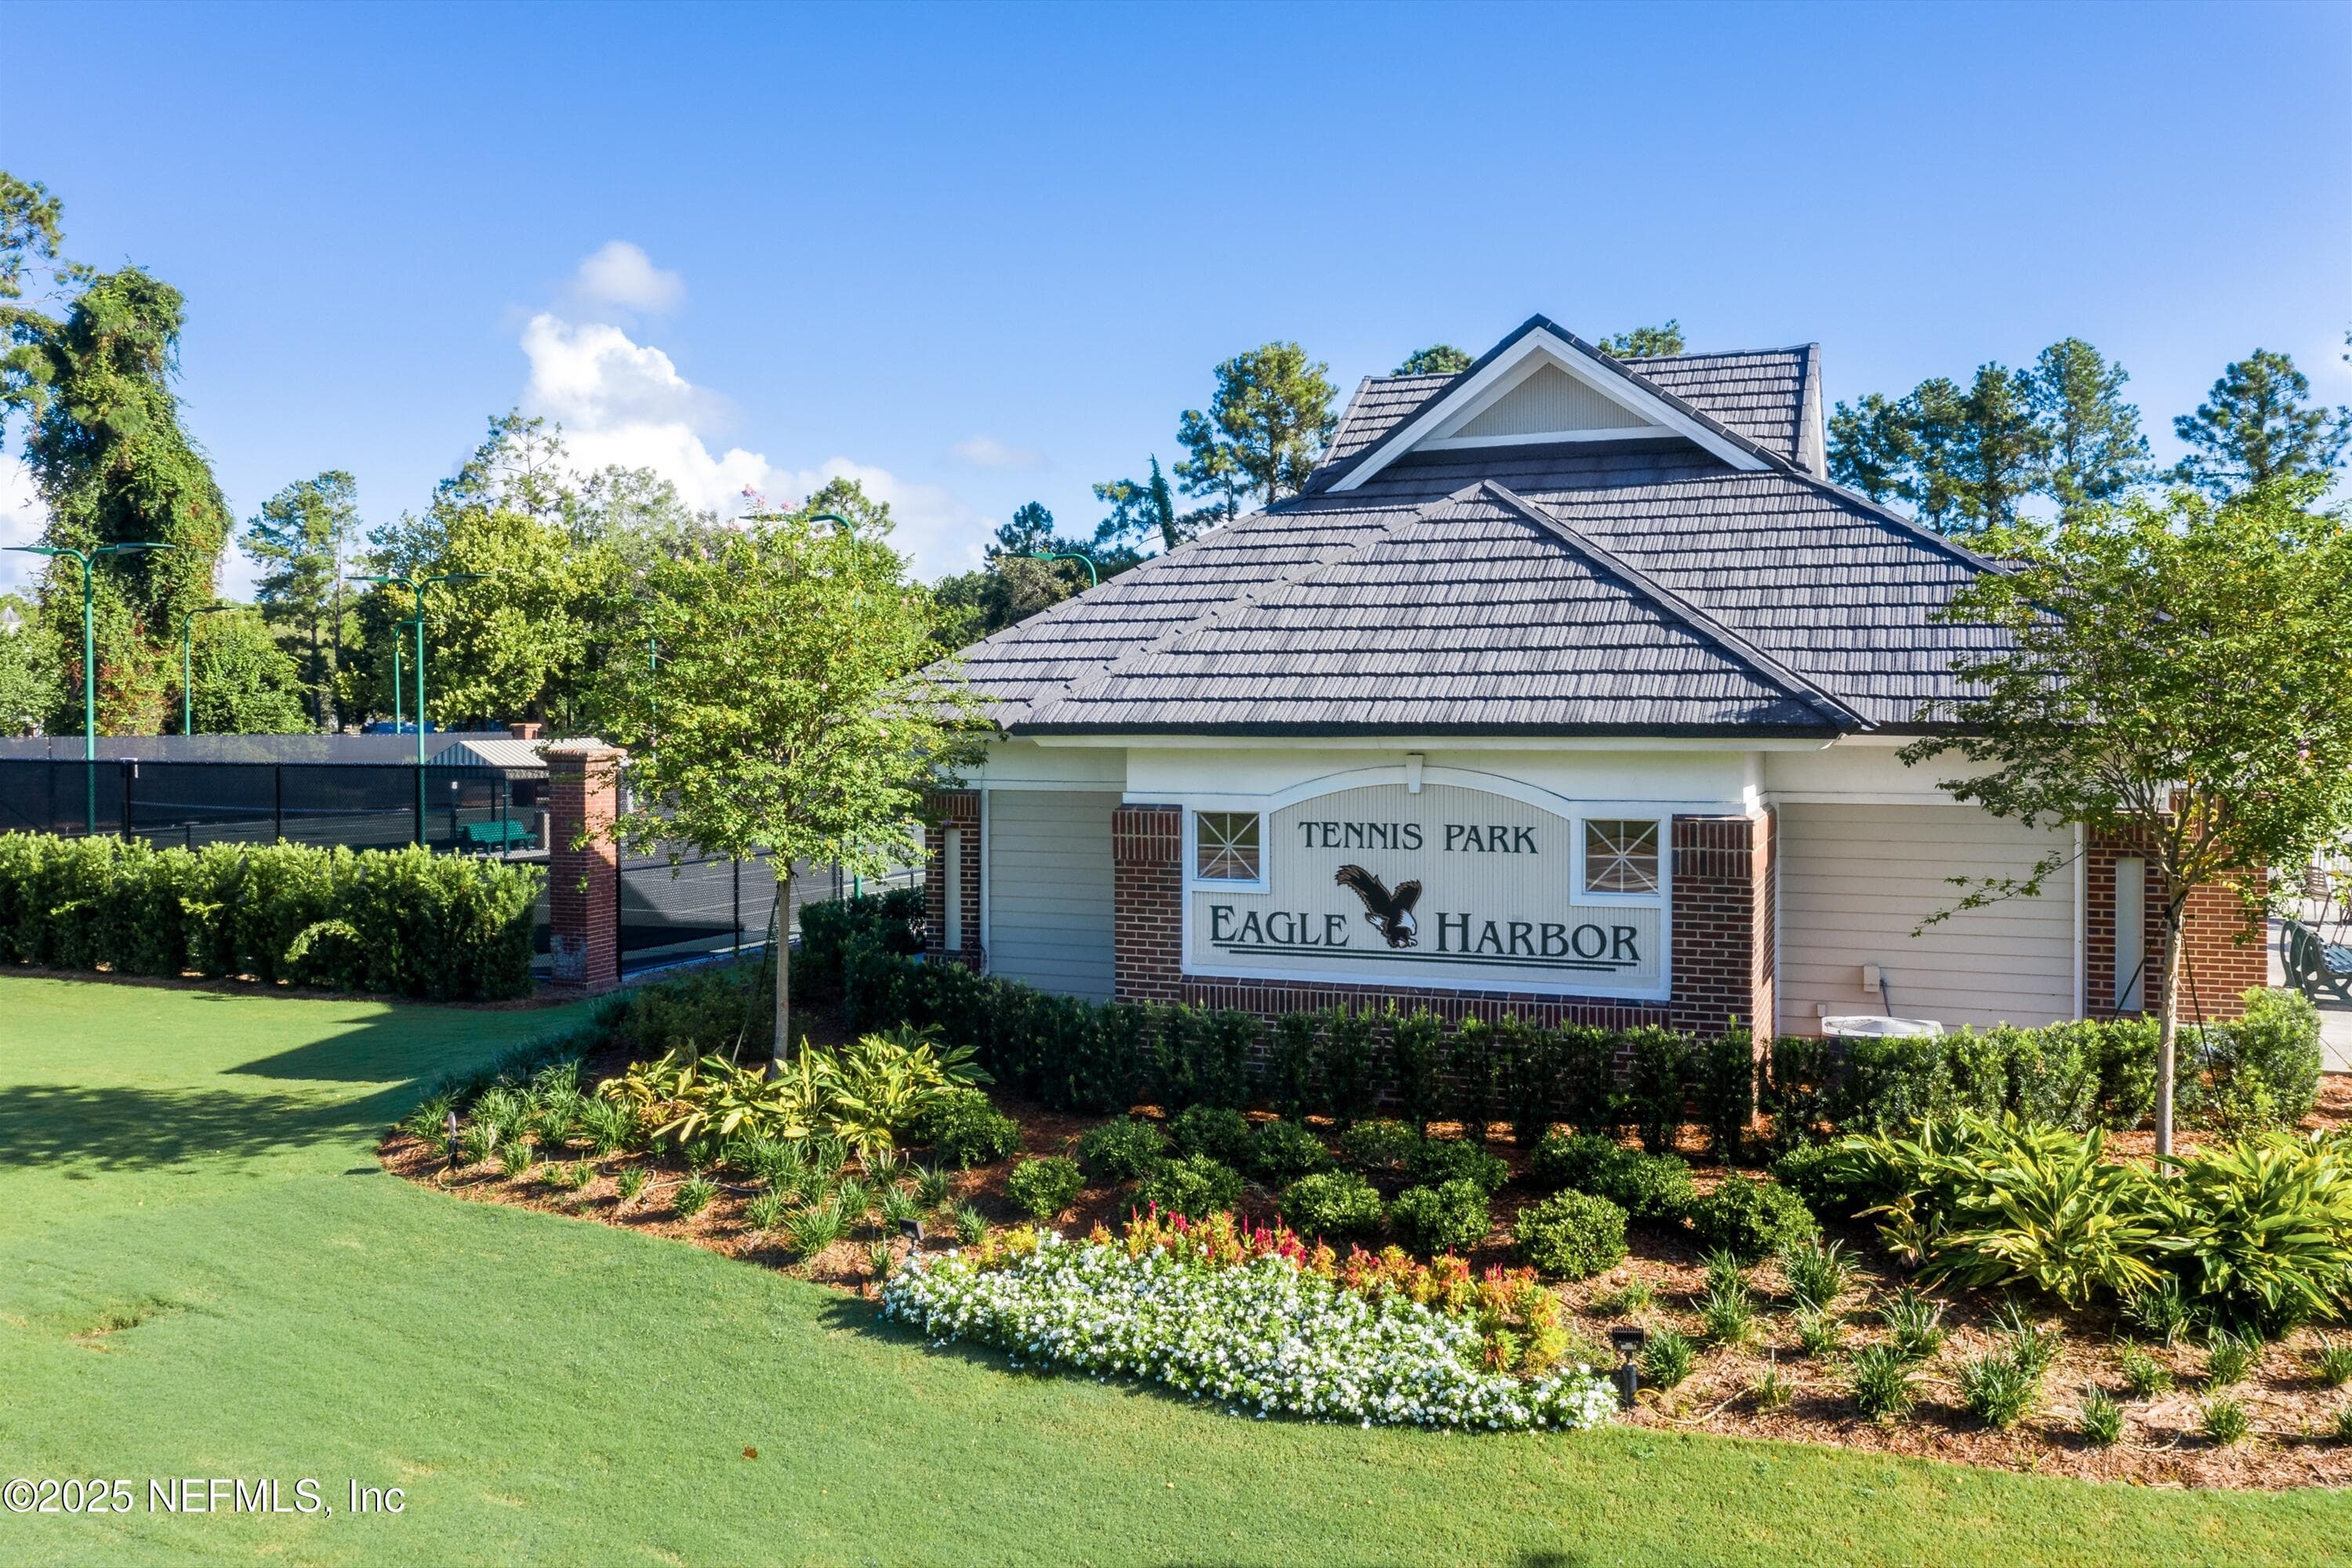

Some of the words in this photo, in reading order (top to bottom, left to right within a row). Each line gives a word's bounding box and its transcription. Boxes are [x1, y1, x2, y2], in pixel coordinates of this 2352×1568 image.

[1298, 821, 1423, 850] TENNIS
[1444, 824, 1538, 855] PARK
[1209, 905, 1349, 946] EAGLE
[1435, 913, 1640, 961] HARBOR
